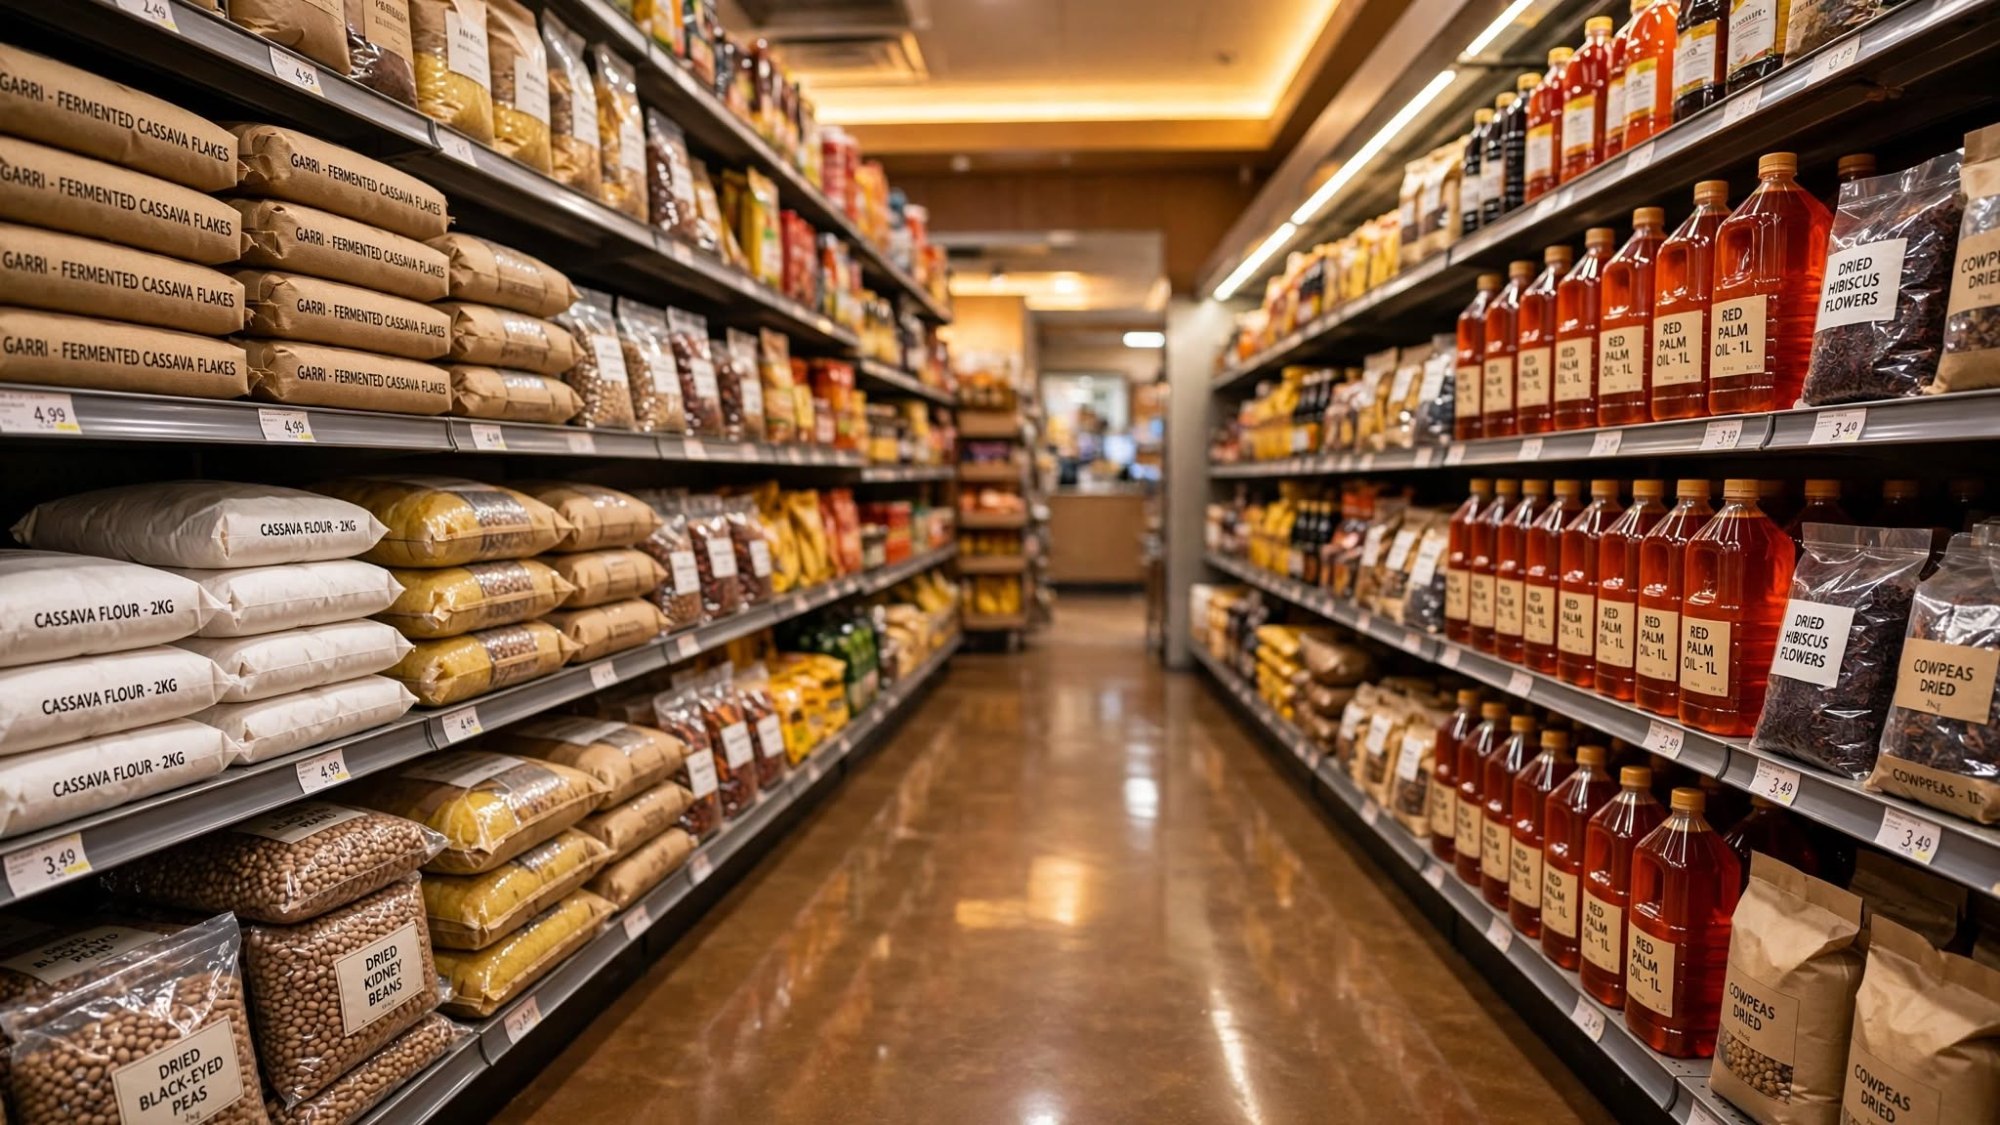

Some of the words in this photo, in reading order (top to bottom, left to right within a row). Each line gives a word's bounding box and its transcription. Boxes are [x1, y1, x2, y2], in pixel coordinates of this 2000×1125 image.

[0, 73, 44, 102] GARRI
[58, 91, 134, 129] FERMENTED
[138, 118, 188, 149] CASSAVA
[191, 136, 229, 162] FLAKES
[291, 153, 320, 174] GARRI
[328, 164, 377, 193] FERMENTED
[379, 182, 414, 206] CASSAVA
[415, 195, 441, 216] FLAKES
[1, 163, 45, 189] GARRI
[59, 177, 136, 210] FERMENTED
[140, 198, 190, 226] CASSAVA
[194, 213, 232, 236] FLAKES
[296, 227, 324, 246] GARRI
[332, 235, 381, 261] FERMENTED
[384, 250, 418, 272] CASSAVA
[419, 260, 445, 278] FLAKES
[1961, 250, 2000, 274] COWP
[1838, 257, 1872, 276] DRIED
[3, 251, 48, 275] GARRI
[62, 260, 139, 289] FERMENTED
[142, 276, 194, 301] CASSAVA
[197, 287, 234, 308] FLAKES
[1828, 273, 1880, 296] HIBISCUS
[1968, 269, 2000, 289] DRIE
[1825, 291, 1879, 313] FLOWERS
[297, 298, 325, 316] GARRI
[334, 304, 383, 326] FERMENTED
[385, 315, 419, 334] CASSAVA
[420, 321, 446, 338] FLAKES
[1722, 307, 1742, 322] RED
[1663, 321, 1682, 335] RED
[1718, 323, 1748, 339] PALM
[1609, 336, 1625, 347] RED
[1660, 336, 1686, 351] PALM
[1715, 343, 1730, 357] OIL
[1740, 341, 1752, 354] 1L
[3, 336, 48, 357] GARRI
[62, 341, 140, 365] FERMENTED
[143, 351, 194, 372] CASSAVA
[198, 358, 236, 376] FLAKES
[1605, 349, 1629, 362] PALM
[1656, 354, 1670, 367] OIL
[1679, 352, 1690, 364] 1L
[1622, 364, 1632, 375] 1L
[297, 365, 326, 382] GARRI
[334, 369, 384, 387] FERMENTED
[386, 375, 420, 391] CASSAVA
[421, 380, 446, 395] FLAKES
[34, 406, 66, 424] 4.99
[285, 420, 305, 434] 4.99
[260, 522, 303, 536] CASSAVA
[304, 520, 333, 534] FLOUR
[340, 520, 356, 532] 2KG
[34, 608, 96, 628] CASSAVA
[99, 603, 140, 621] FLOUR
[151, 599, 174, 615] 2KG
[1604, 607, 1618, 619] RED
[1644, 615, 1661, 628] RED
[1795, 614, 1825, 630] DRIED
[1601, 620, 1622, 634] PALM
[1641, 629, 1664, 645] PALM
[1690, 625, 1709, 640] RED
[1615, 637, 1624, 649] 1L
[1687, 640, 1714, 658] PALM
[1785, 631, 1829, 650] HIBISCUS
[1657, 649, 1668, 661] 1L
[1780, 647, 1826, 668] FLOWERS
[1684, 656, 1698, 671] OIL
[1705, 661, 1718, 675] 1L
[1914, 658, 1974, 682] COWPEAS
[42, 691, 102, 715] CASSAVA
[104, 684, 145, 704] FLOUR
[154, 678, 178, 695] 2KG
[1920, 679, 1957, 697] DRIED
[53, 770, 111, 798] CASSAVA
[114, 759, 153, 781] FLOUR
[162, 751, 185, 769] 2KG
[321, 761, 340, 778] 4.99
[1770, 777, 1792, 796] 3.49
[43, 848, 76, 875] 3.49
[1589, 901, 1604, 918] RED
[1586, 914, 1607, 936] PALM
[1600, 938, 1610, 952] 1L
[1636, 935, 1653, 954] RED
[366, 945, 397, 971] DRIED
[1633, 949, 1657, 974] PALM
[364, 959, 402, 991] KIDNEY
[1630, 963, 1642, 982] OIL
[1650, 977, 1661, 993] 1L
[369, 977, 402, 1006] BEANS
[1729, 982, 1775, 1020] COWPEAS
[1733, 1004, 1762, 1031] DRIED
[159, 1048, 201, 1080] DRIED
[139, 1056, 223, 1111] BLACK-EYED
[1854, 1063, 1911, 1112] COWPEAS
[172, 1085, 207, 1116] PEAS
[1861, 1089, 1896, 1124] DRIED
